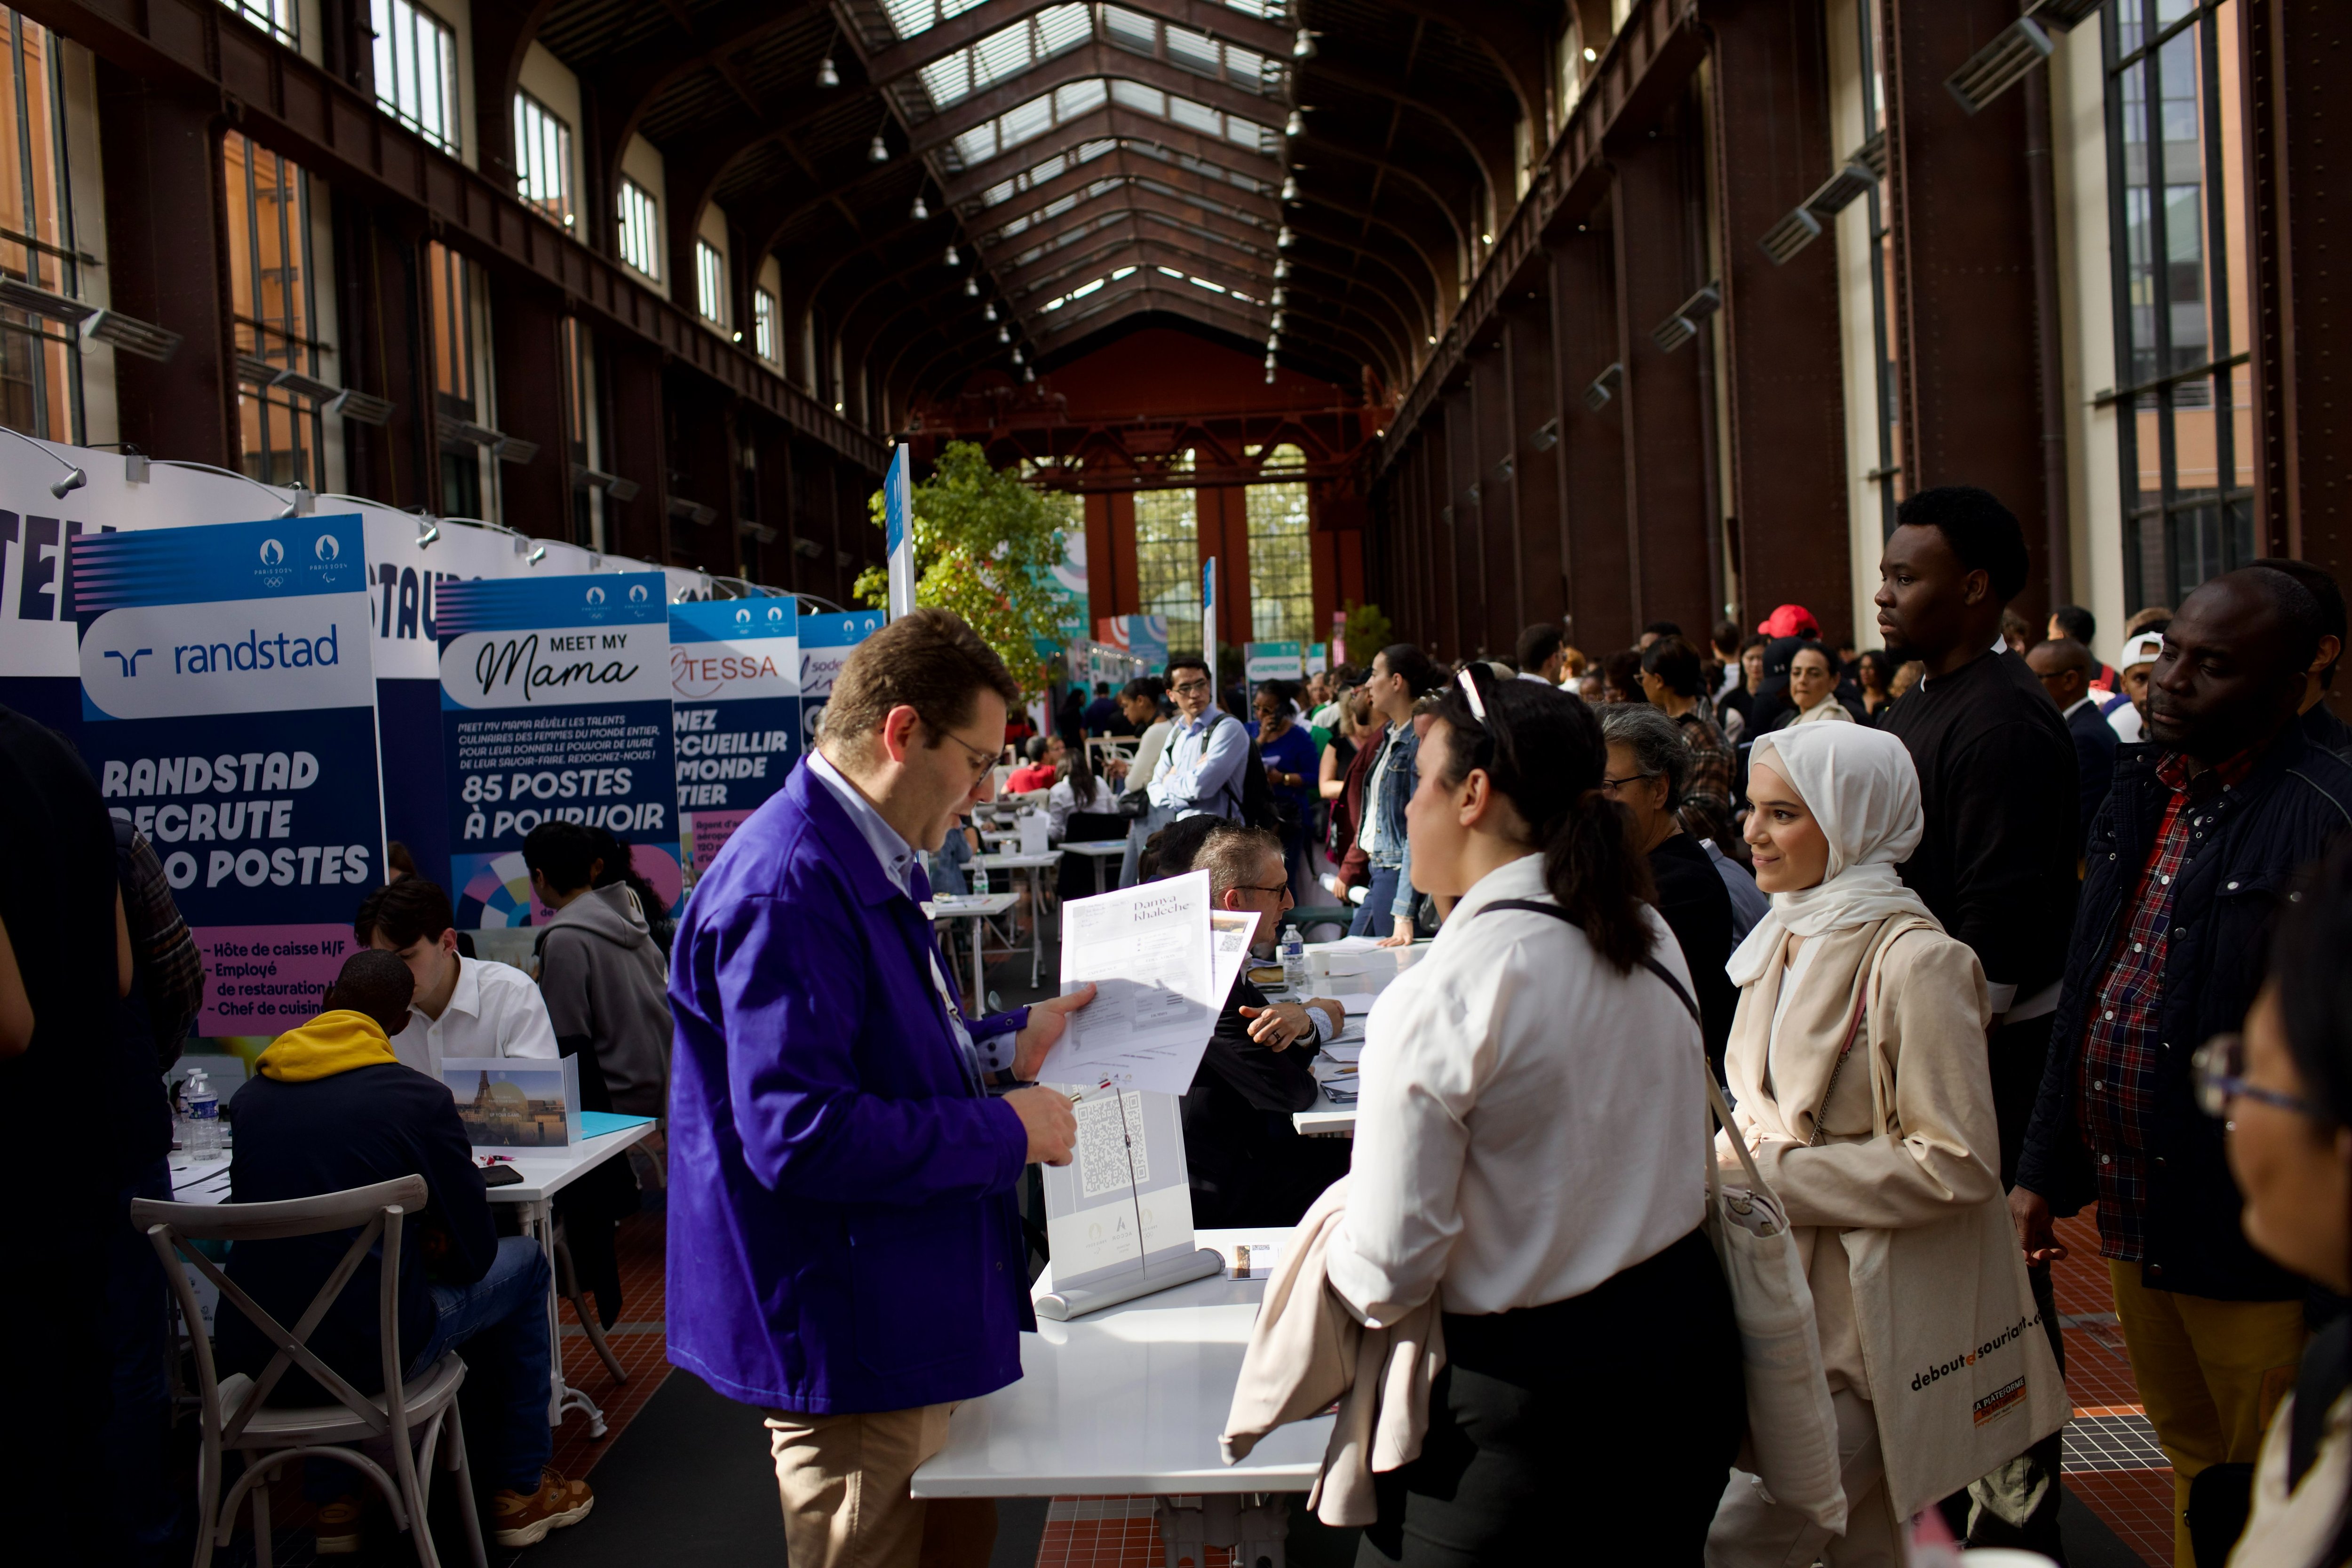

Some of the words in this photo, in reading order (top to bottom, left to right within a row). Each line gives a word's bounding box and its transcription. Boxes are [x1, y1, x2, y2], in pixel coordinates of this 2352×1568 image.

[175, 624, 338, 674] randstad
[550, 636, 596, 652] MEET
[603, 634, 627, 649] MY
[476, 634, 638, 700] Mama
[458, 722, 483, 733] MEET
[485, 721, 500, 731] MY
[501, 720, 532, 730] MAMA
[534, 716, 567, 729] RÉVÈLE
[569, 717, 584, 727] LES
[587, 715, 626, 726] TALENTS
[459, 733, 513, 745] CULINAIRES
[515, 732, 532, 742] DES
[534, 730, 573, 741] FEMMES
[575, 729, 588, 739] DU
[590, 727, 626, 738] MONDE
[459, 746, 487, 757] POUR
[489, 745, 512, 756] LEUR
[513, 743, 553, 755] DONNER
[555, 742, 565, 752] LE
[567, 740, 611, 752] POUVOIR
[613, 740, 625, 749] DE
[627, 738, 654, 748] VIVRE
[460, 760, 472, 770] DE
[474, 758, 496, 769] LEUR
[568, 751, 650, 764] REJOIGNEZ-NOUS
[677, 756, 768, 781] MONDE
[102, 751, 319, 797] RANDSTAD
[461, 774, 502, 804] 85
[509, 768, 633, 801] POSTES
[463, 803, 486, 840] À
[207, 845, 369, 887] POSTES
[1133, 903, 1190, 922] Khaleche
[1134, 896, 1176, 911] Damya
[214, 942, 248, 957] Hôte
[252, 943, 269, 955] de
[273, 941, 318, 955] caisse
[322, 941, 344, 957] H/F
[216, 961, 277, 979] Employé
[217, 983, 235, 995] de
[239, 980, 325, 995] restauration
[218, 1002, 254, 1015] Chef
[257, 1002, 275, 1014] de
[1983, 1377, 2025, 1408] PLATEFORME
